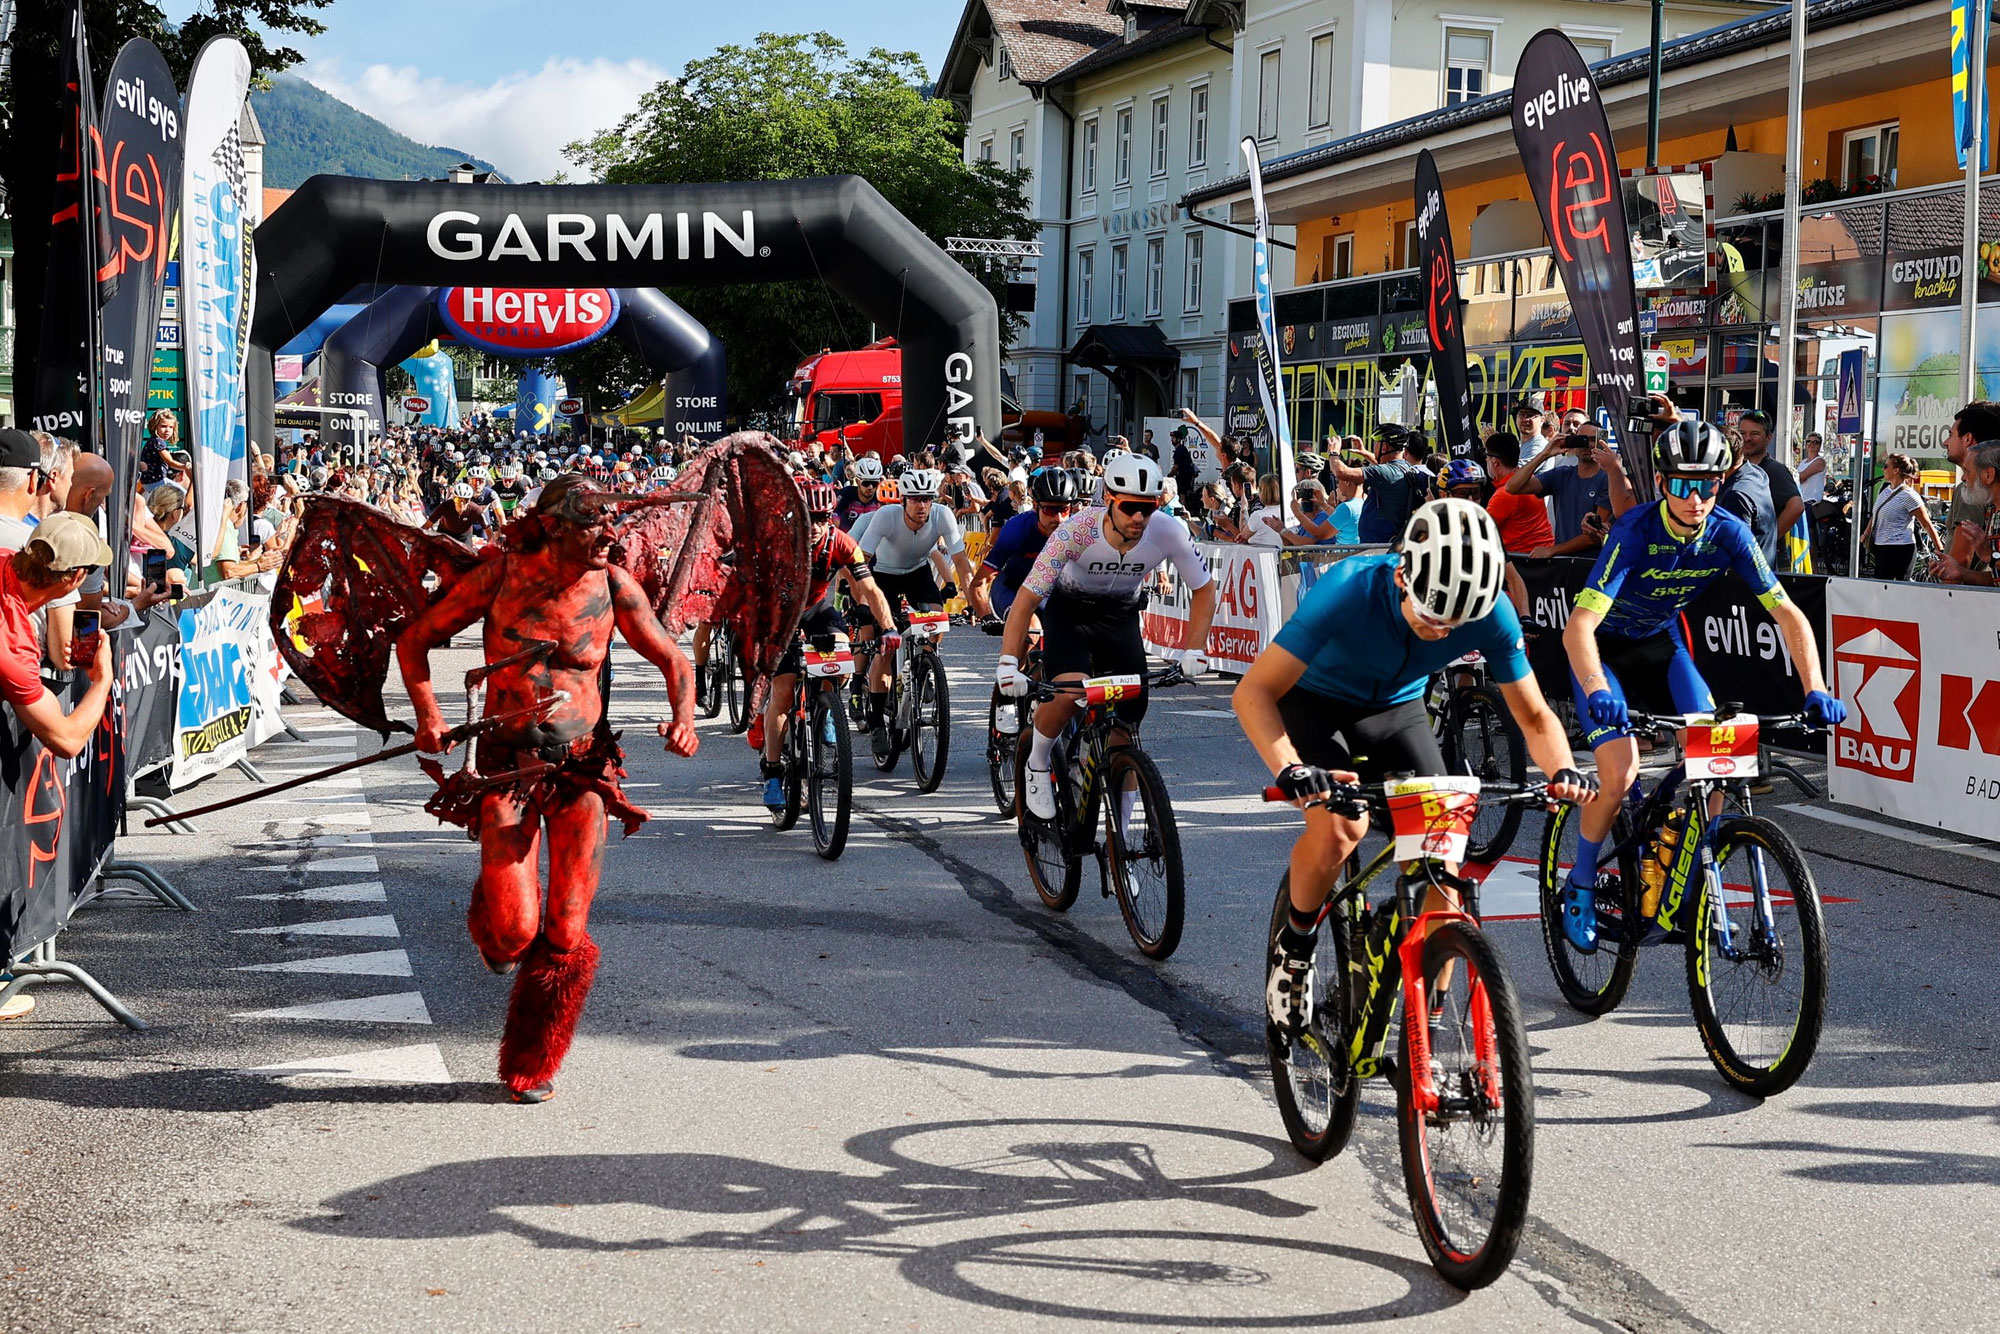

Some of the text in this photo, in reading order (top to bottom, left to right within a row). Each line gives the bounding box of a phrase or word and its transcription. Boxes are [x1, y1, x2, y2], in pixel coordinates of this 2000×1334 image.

[116, 77, 177, 142] evil eye
[427, 210, 755, 262] GARMIN
[1892, 255, 1962, 284] GESUND
[193, 170, 214, 400] FACHDISKONT
[1914, 272, 1957, 299] knackig
[463, 288, 603, 334] Hervis
[159, 328, 177, 341] 145
[475, 327, 541, 337] SPORTS
[1332, 323, 1370, 340] REGIONAL
[105, 345, 124, 364] true
[1676, 345, 1690, 354] Post
[330, 393, 373, 405] STORE
[676, 396, 717, 408] STORE
[675, 421, 723, 433] ONLINE
[1229, 405, 1258, 435] Genuss
[1088, 561, 1146, 573] nora
[1641, 567, 1721, 580] Kaiser
[1535, 587, 1571, 630] evil
[1704, 605, 1751, 657] evil
[1218, 632, 1257, 656] Service
[1104, 685, 1124, 700] B3
[1710, 726, 1736, 745] B4
[1711, 746, 1732, 754] Luca
[1839, 735, 1911, 771] BAU
[1657, 809, 1700, 932] Kaiser
[1288, 959, 1310, 971] SIDI
